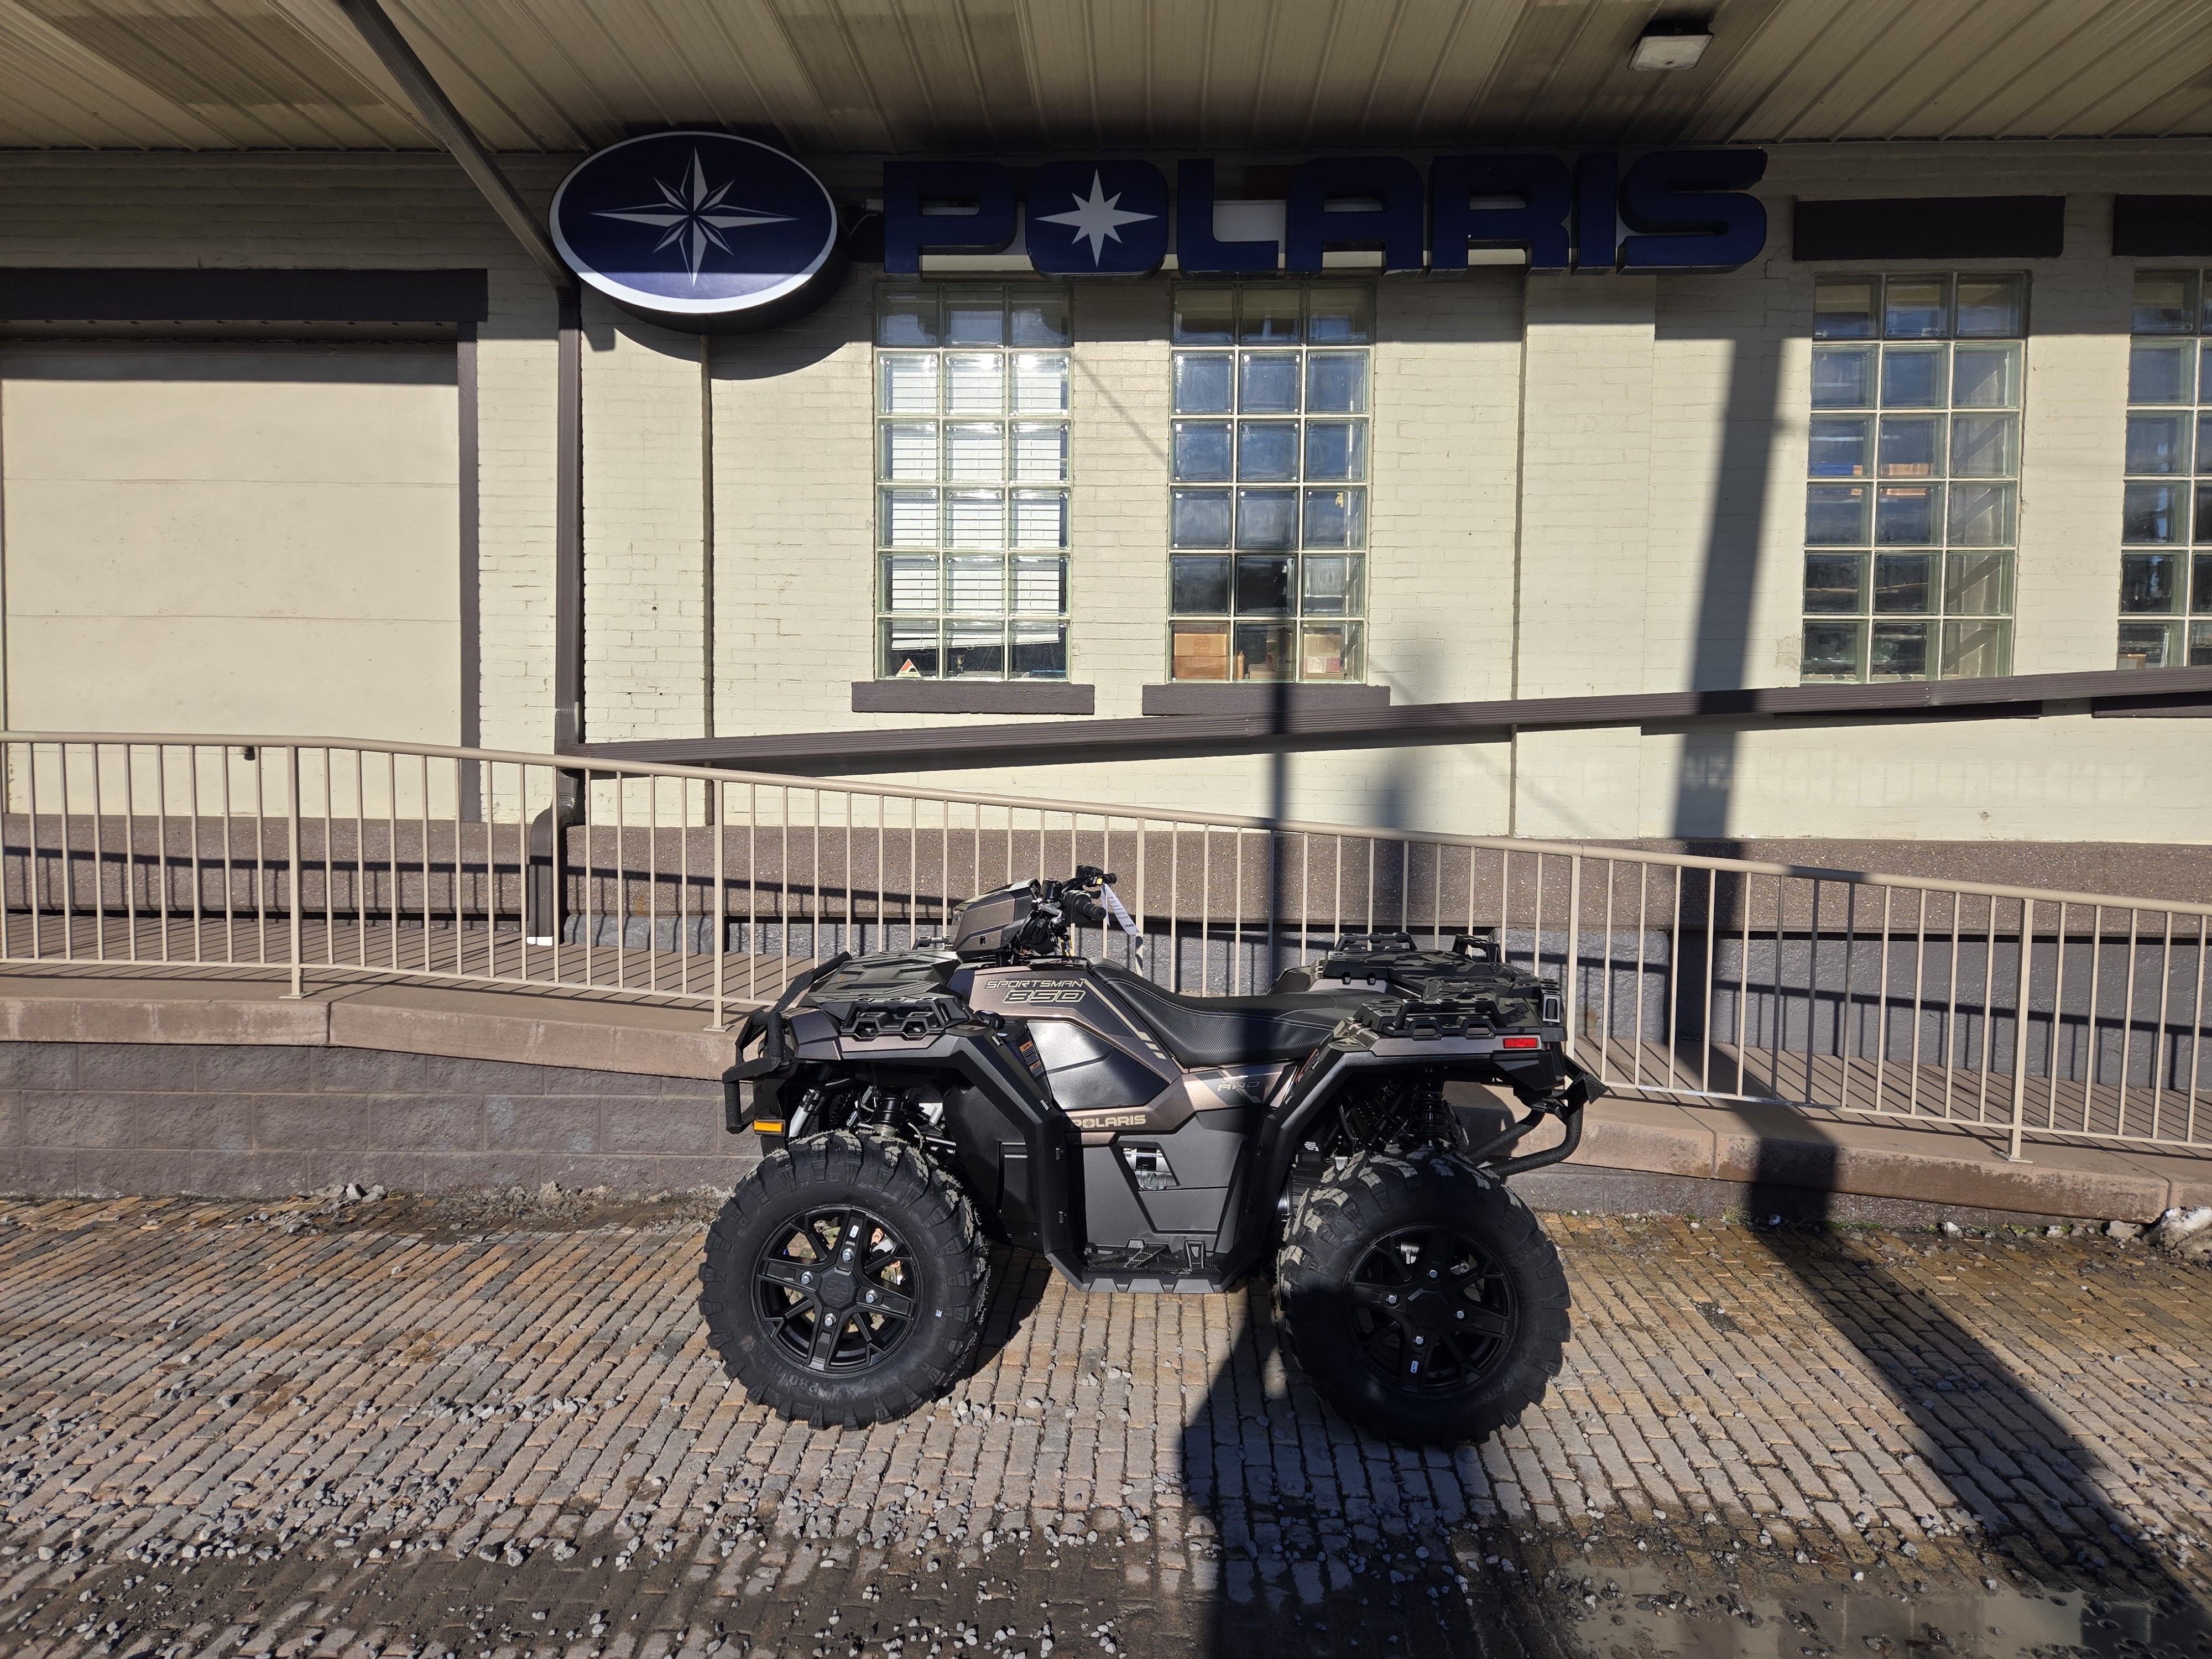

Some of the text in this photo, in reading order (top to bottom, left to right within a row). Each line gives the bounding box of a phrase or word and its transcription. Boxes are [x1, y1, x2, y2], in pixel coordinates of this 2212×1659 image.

[884, 148, 1768, 275] POLARIS
[985, 980, 1084, 989] SPORTSMAN
[1003, 989, 1086, 1004] 850
[1217, 1081, 1260, 1092] AWD
[1070, 1114, 1147, 1129] POLARIS
